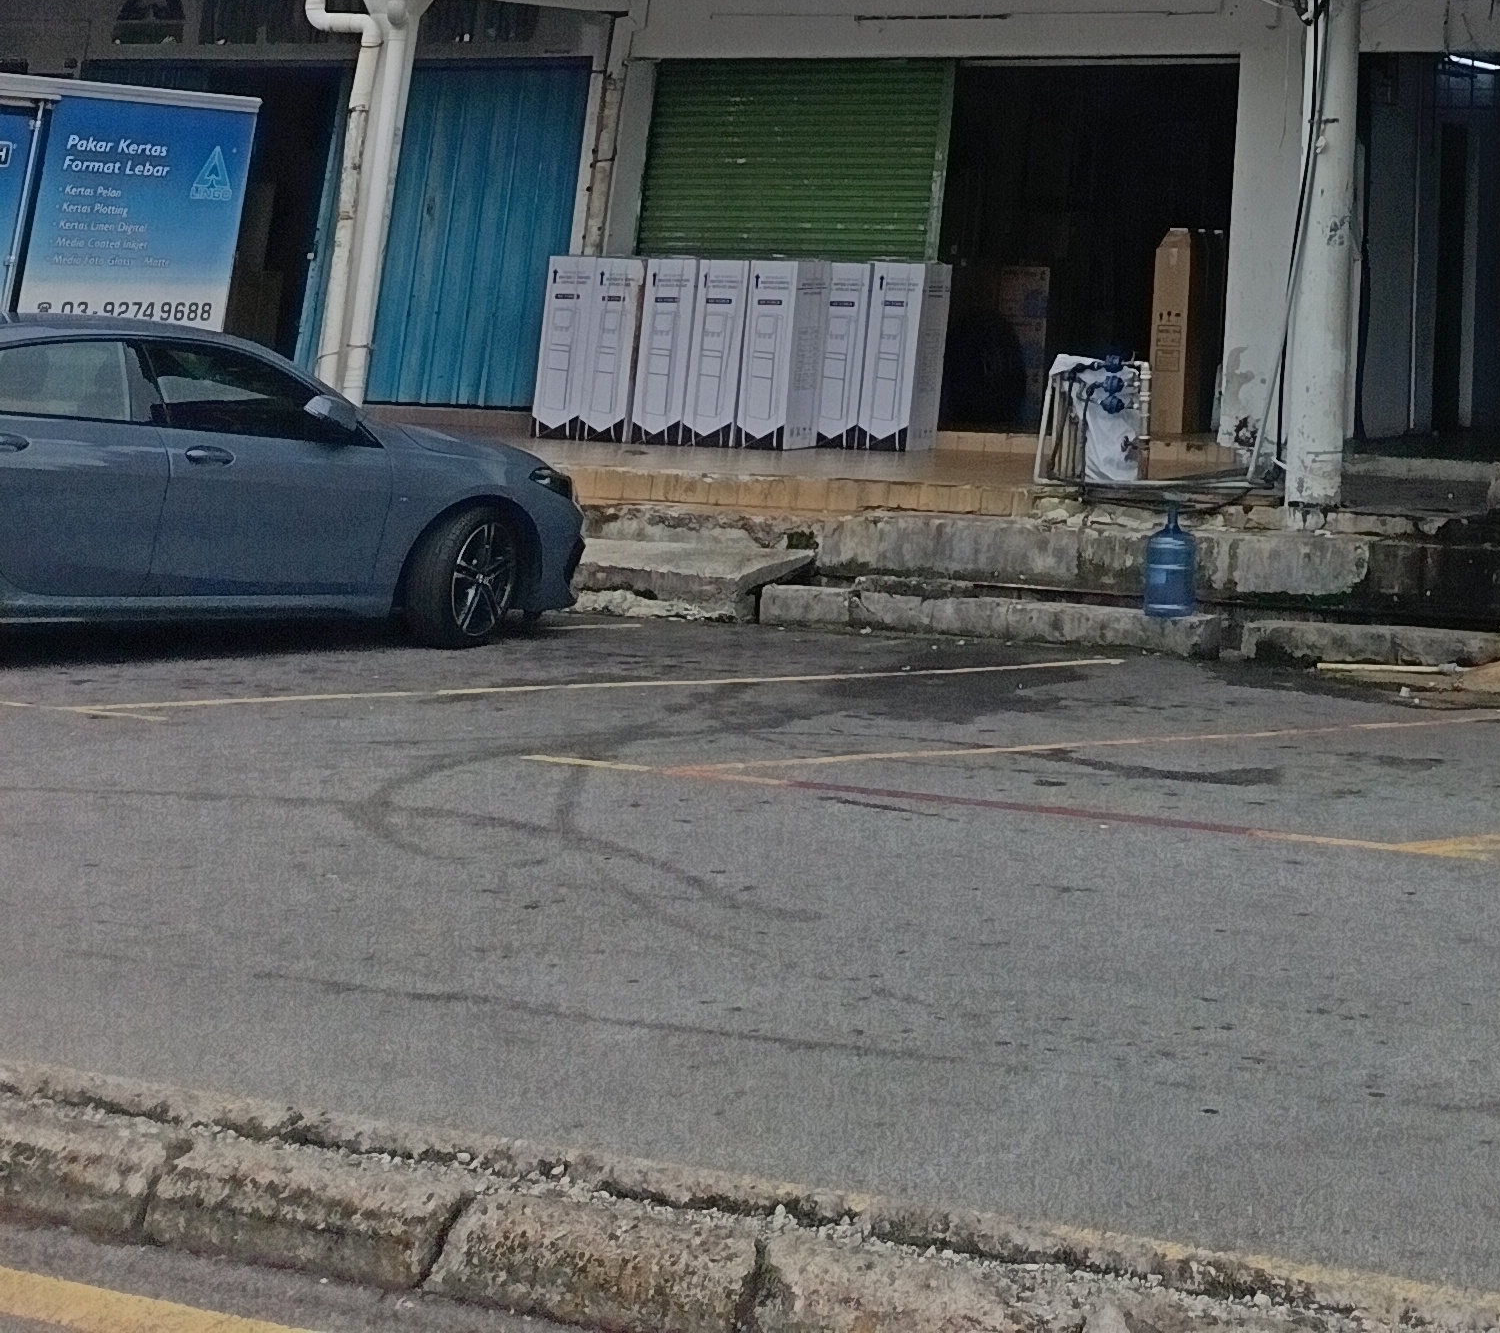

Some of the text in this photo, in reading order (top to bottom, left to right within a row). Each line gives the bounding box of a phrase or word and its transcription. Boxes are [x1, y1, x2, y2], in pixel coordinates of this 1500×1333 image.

[66, 134, 168, 157] Pakar Kertas
[62, 155, 170, 177] Format Lebar
[64, 184, 94, 196] Kertas
[62, 201, 129, 218] Kertas Plotting
[58, 220, 88, 231] Kertas
[55, 237, 85, 248] Media
